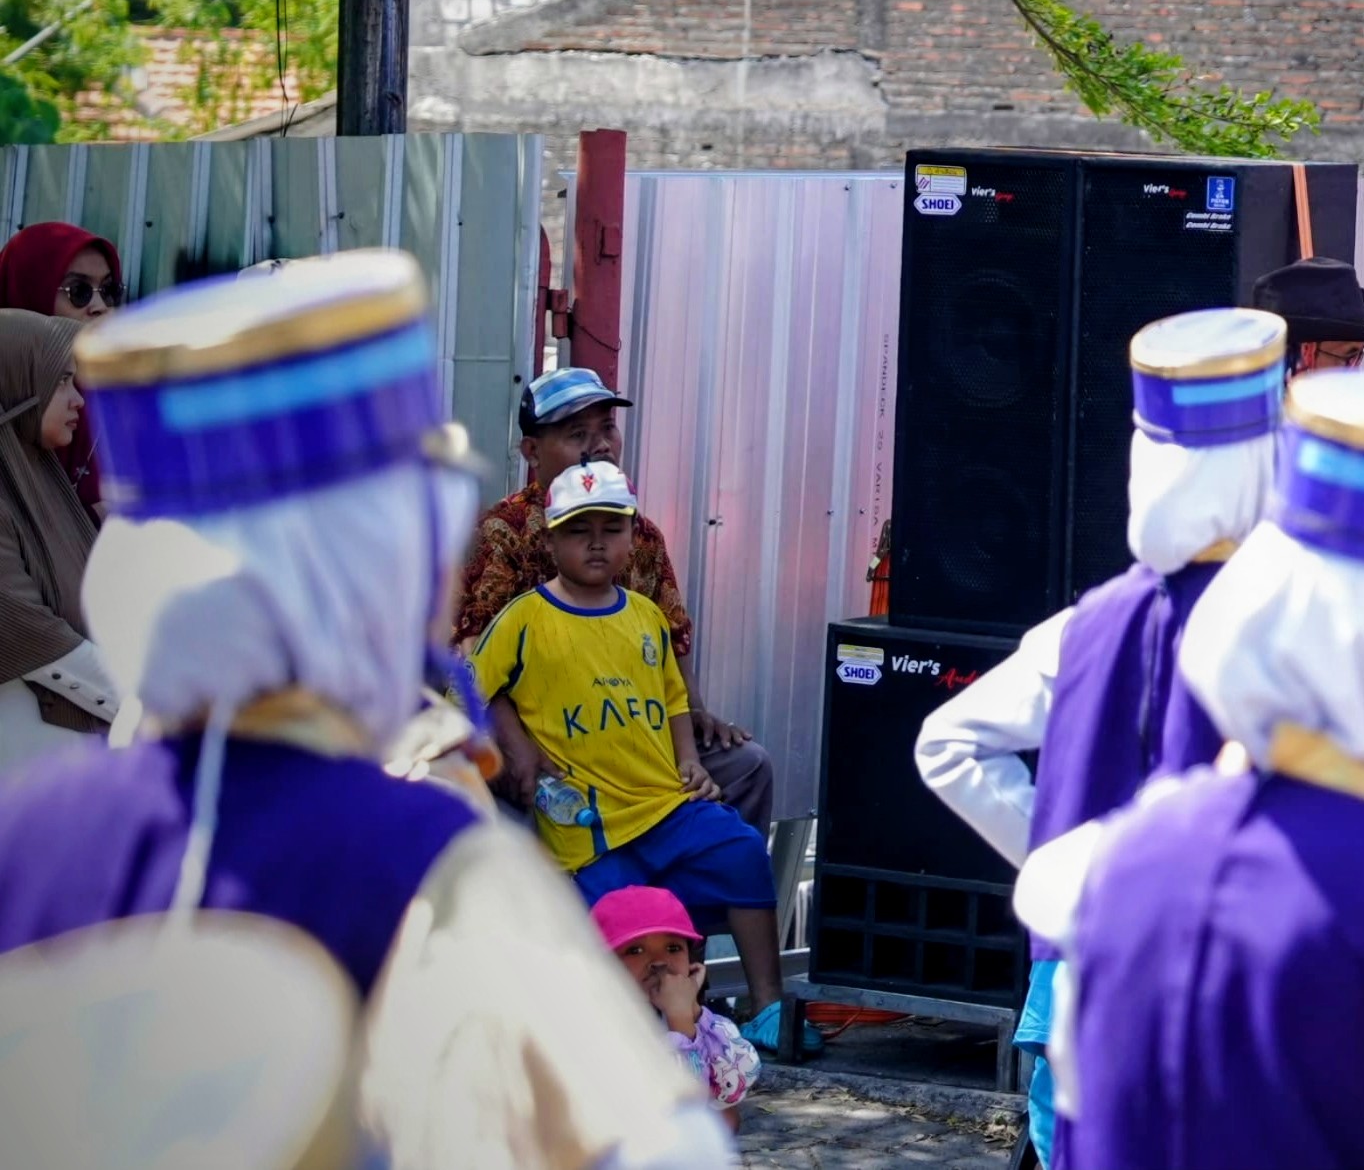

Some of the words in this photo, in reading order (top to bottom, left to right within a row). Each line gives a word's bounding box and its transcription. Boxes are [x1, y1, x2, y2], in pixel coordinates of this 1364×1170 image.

[921, 198, 954, 210] SHOEI
[892, 654, 941, 676] Vier's
[843, 666, 875, 680] SHOEI
